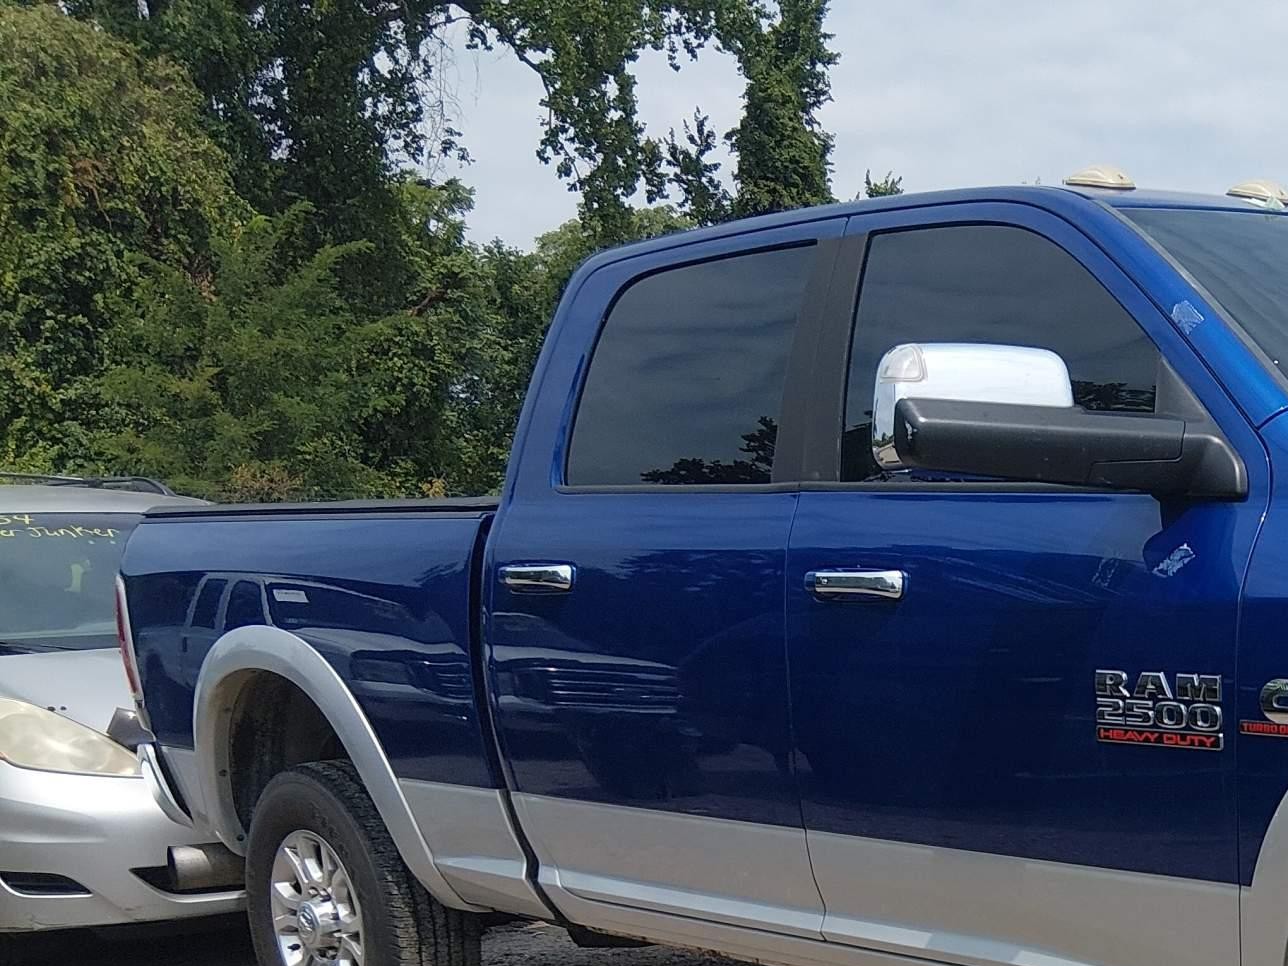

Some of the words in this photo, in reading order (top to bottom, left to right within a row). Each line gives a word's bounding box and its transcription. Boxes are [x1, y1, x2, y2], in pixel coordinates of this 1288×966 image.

[1095, 669, 1222, 701] RAM
[1096, 698, 1222, 732] 2500
[1099, 728, 1159, 743] HEAVY
[1162, 735, 1217, 748] DUTY
[1242, 722, 1278, 735] TURBO
